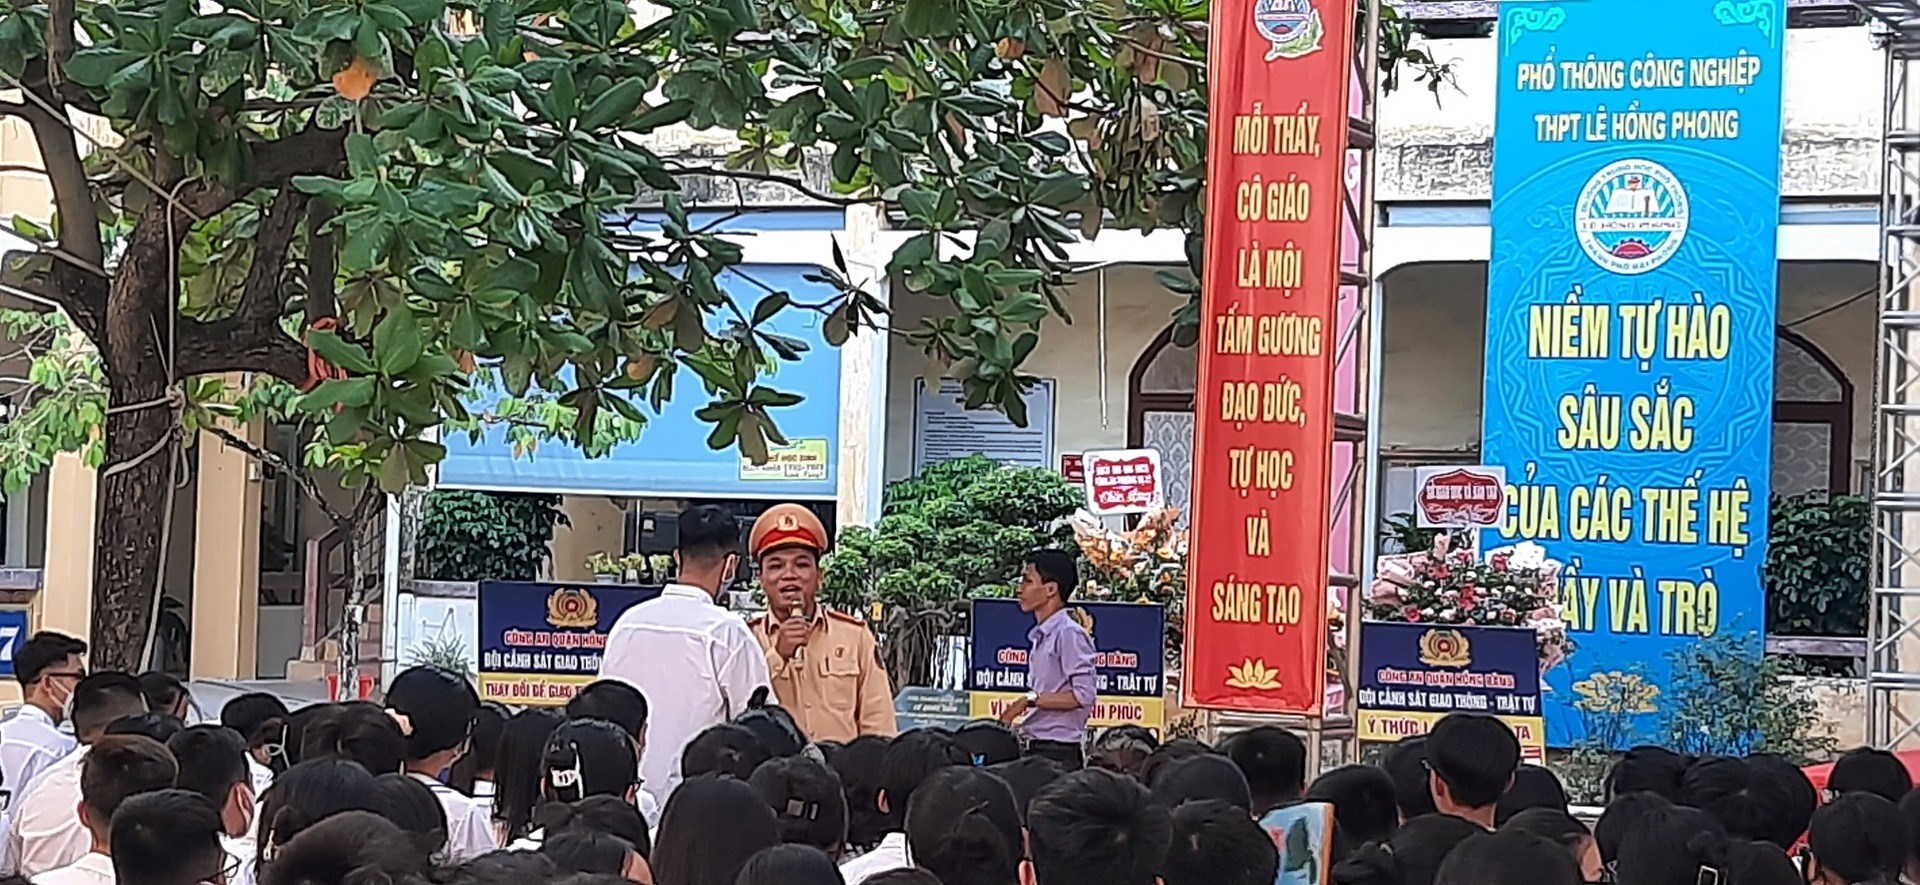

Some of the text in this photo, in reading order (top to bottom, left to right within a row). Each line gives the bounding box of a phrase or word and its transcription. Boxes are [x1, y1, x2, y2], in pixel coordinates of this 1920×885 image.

[1517, 46, 1761, 95] PHỔ THÔNG CÔNG NGHIỆP
[1534, 113, 1582, 142] THPT
[1585, 104, 1607, 141] LÊ
[1671, 110, 1739, 139] PHONG
[1236, 173, 1310, 221] CÔ GIÁO
[1238, 240, 1261, 288] LÀ
[1216, 301, 1321, 356] TẤM GƯƠNG
[1528, 284, 1732, 372] NIỀM TỰ HÀO
[1221, 374, 1307, 431] ĐẠO ĐỨC,
[1557, 376, 1694, 452] SÂU SẮC
[1228, 445, 1294, 499] TỰ HỌC
[1246, 509, 1270, 556] VÀ
[1500, 462, 1750, 559] CỦA CÁC THẾ HỆ
[1211, 574, 1302, 633] SÁNG TẠO
[1560, 557, 1718, 637] ẦY VÀ TRÒ
[504, 629, 534, 645] CÔNG
[535, 632, 551, 646] AN
[533, 651, 552, 669] SÁT
[554, 655, 578, 670] GIAO
[581, 652, 602, 670] THÔ
[486, 683, 510, 698] THAY
[549, 684, 572, 698] GIAO
[1378, 667, 1407, 683] CÔNG
[1408, 690, 1426, 707] SÁT
[1429, 693, 1452, 708] GIAO
[1454, 691, 1487, 709] THÔNG
[1381, 717, 1418, 734] THỨC
